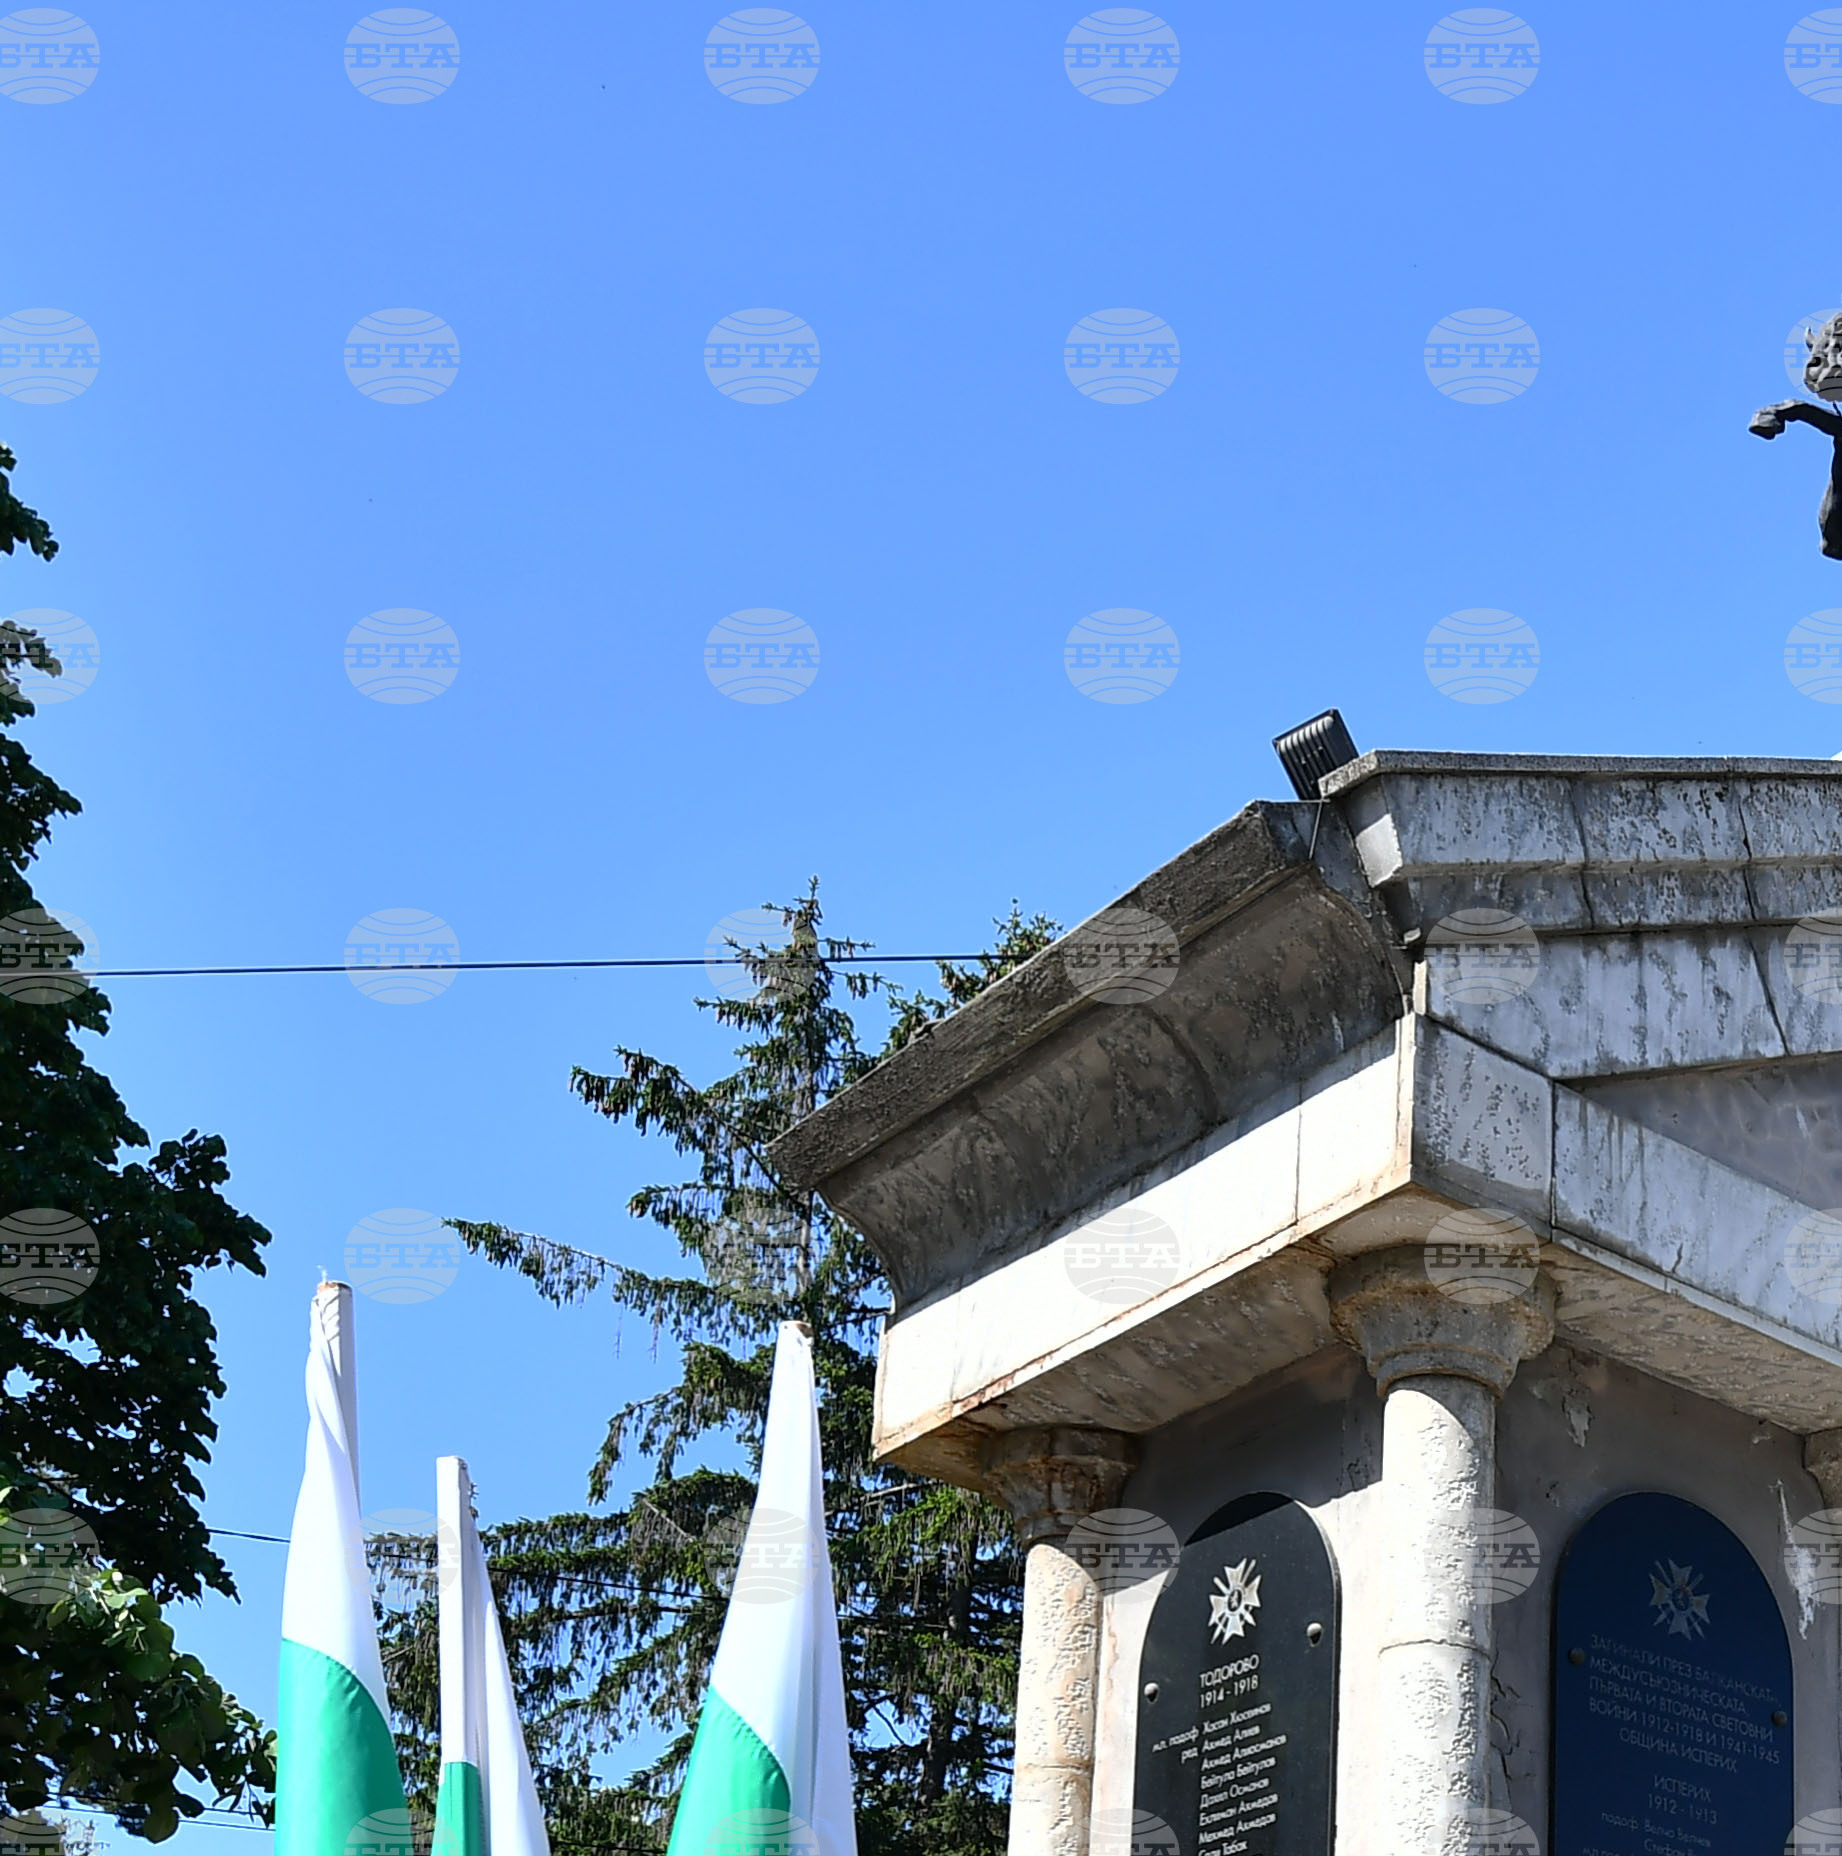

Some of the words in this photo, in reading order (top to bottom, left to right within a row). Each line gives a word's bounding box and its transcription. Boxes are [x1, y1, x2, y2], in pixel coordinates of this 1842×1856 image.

[1200, 1655, 1259, 1688] ТОДОРОВО
[1664, 1656, 1692, 1678] ПРЕЗ
[1200, 1689, 1224, 1708] 1914
[1234, 1675, 1258, 1696] 1918
[1590, 1676, 1642, 1702] ПЪРВАТА
[1646, 1694, 1657, 1709] И
[1660, 1697, 1709, 1724] ВТОРАТА
[1712, 1713, 1773, 1742] СВЕТОВНИ
[1590, 1696, 1637, 1723] ВОЙНИ
[1642, 1712, 1703, 1742] 1912-1918
[1706, 1731, 1716, 1746] И
[1721, 1735, 1780, 1765] 1941-1945
[1202, 1736, 1232, 1753] Ахмед
[1619, 1728, 1678, 1756] ОБЩИНА
[1681, 1744, 1738, 1773] ИСПЕРИХ
[1201, 1754, 1231, 1771] Ахмед
[1230, 1778, 1269, 1797] Османов
[1654, 1774, 1711, 1803] ИСПЕРИХ
[1238, 1794, 1278, 1813] Ахмедов
[1648, 1793, 1676, 1814] 1912
[1236, 1814, 1276, 1833] Ахмедов
[1223, 1840, 1247, 1855] Табак
